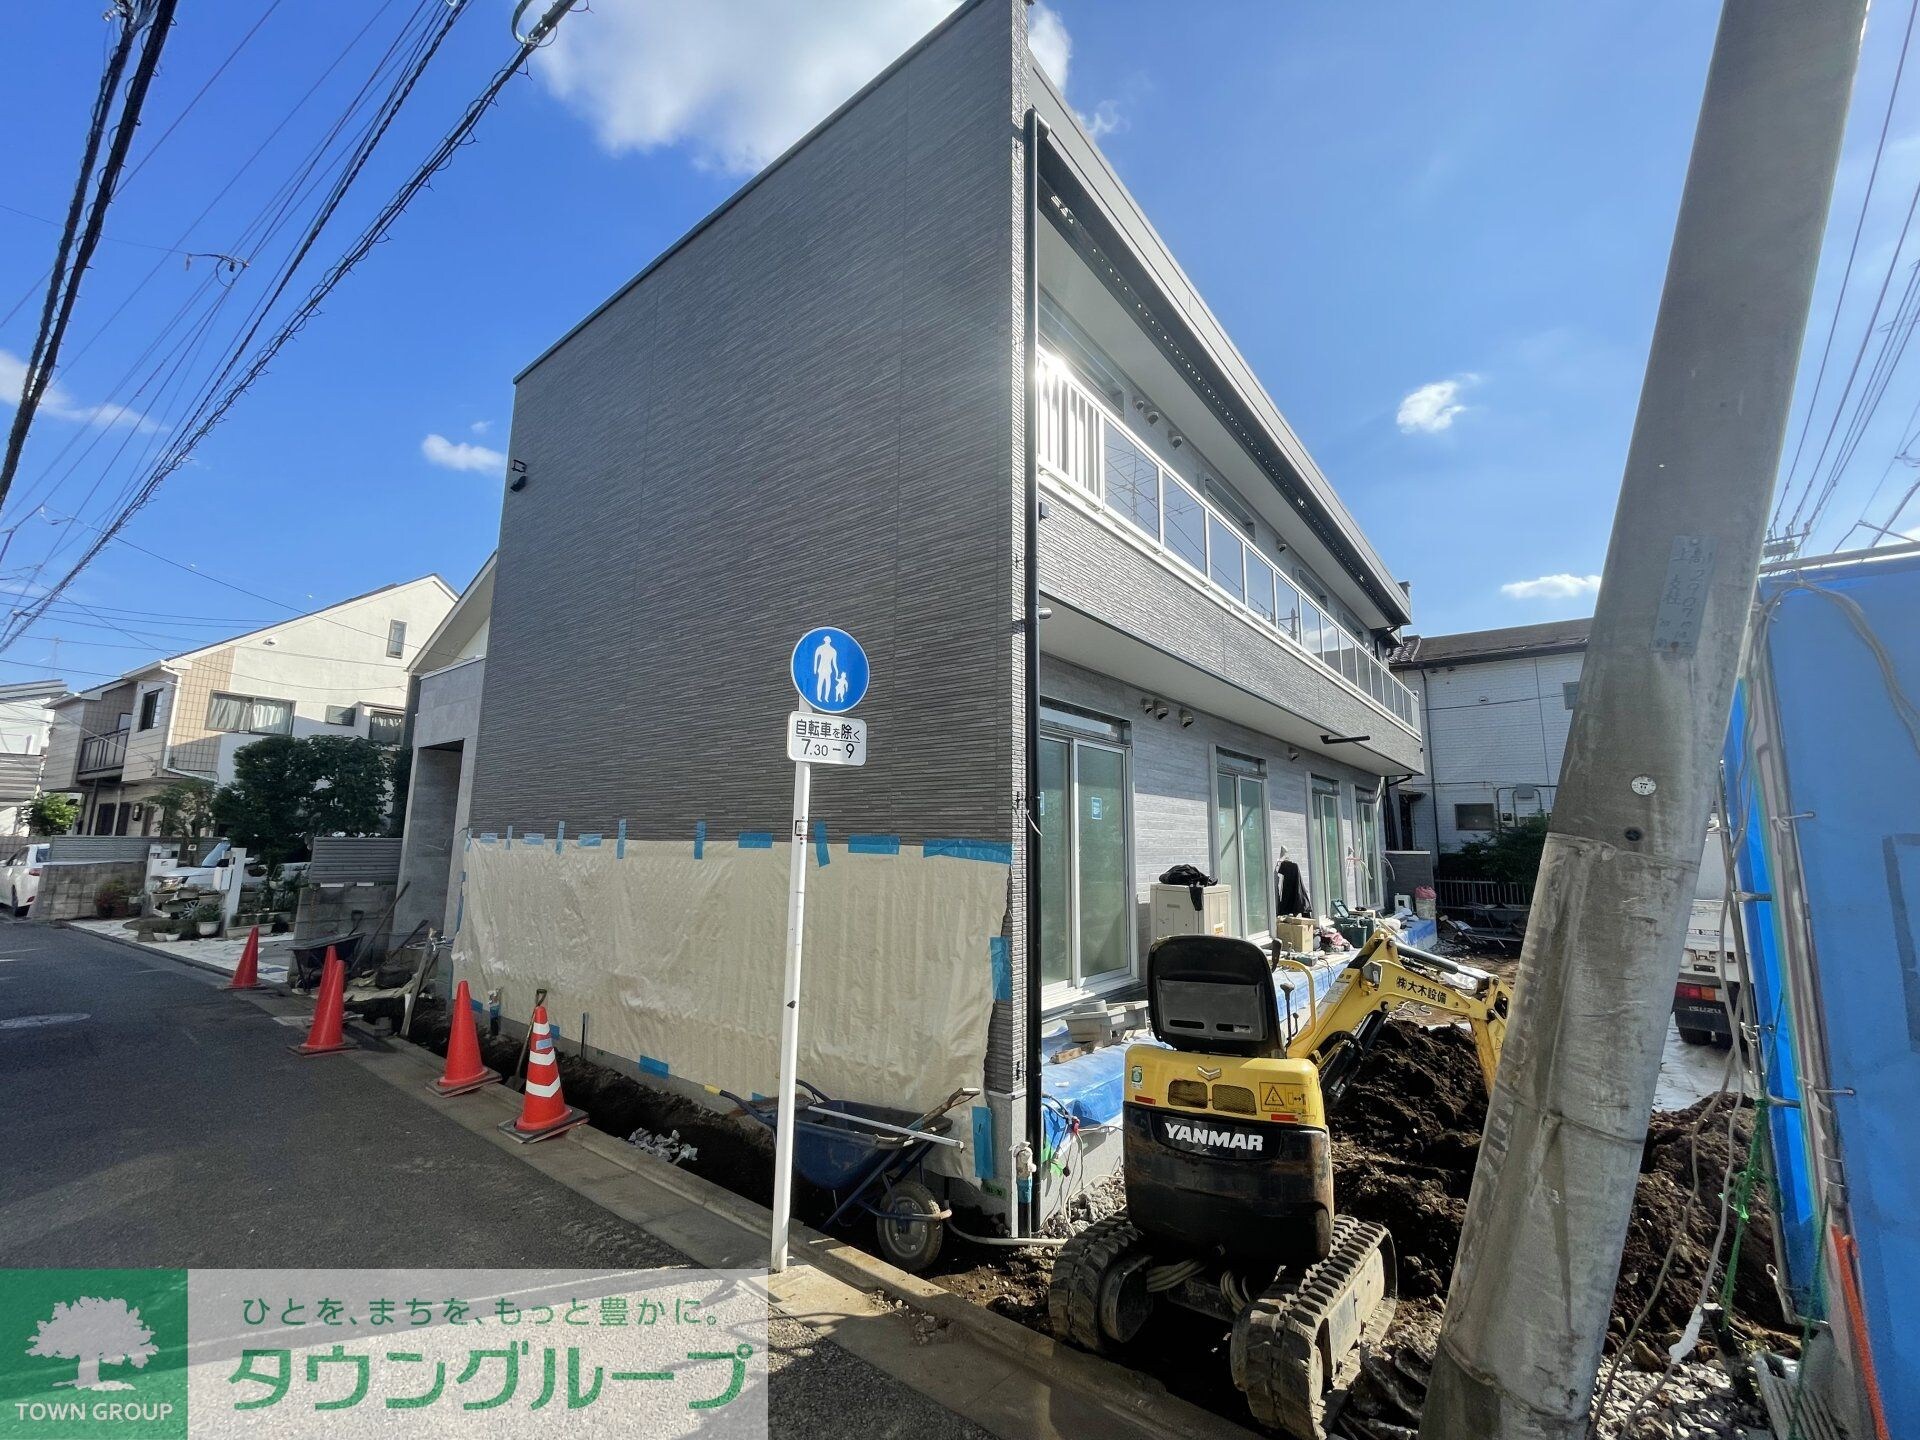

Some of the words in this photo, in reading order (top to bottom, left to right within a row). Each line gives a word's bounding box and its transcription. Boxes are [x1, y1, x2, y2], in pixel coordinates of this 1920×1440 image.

[795, 719, 860, 741] 自転車を除く
[1688, 1005, 1722, 1014] ISUZU
[1164, 1122, 1264, 1152] YANMAR
